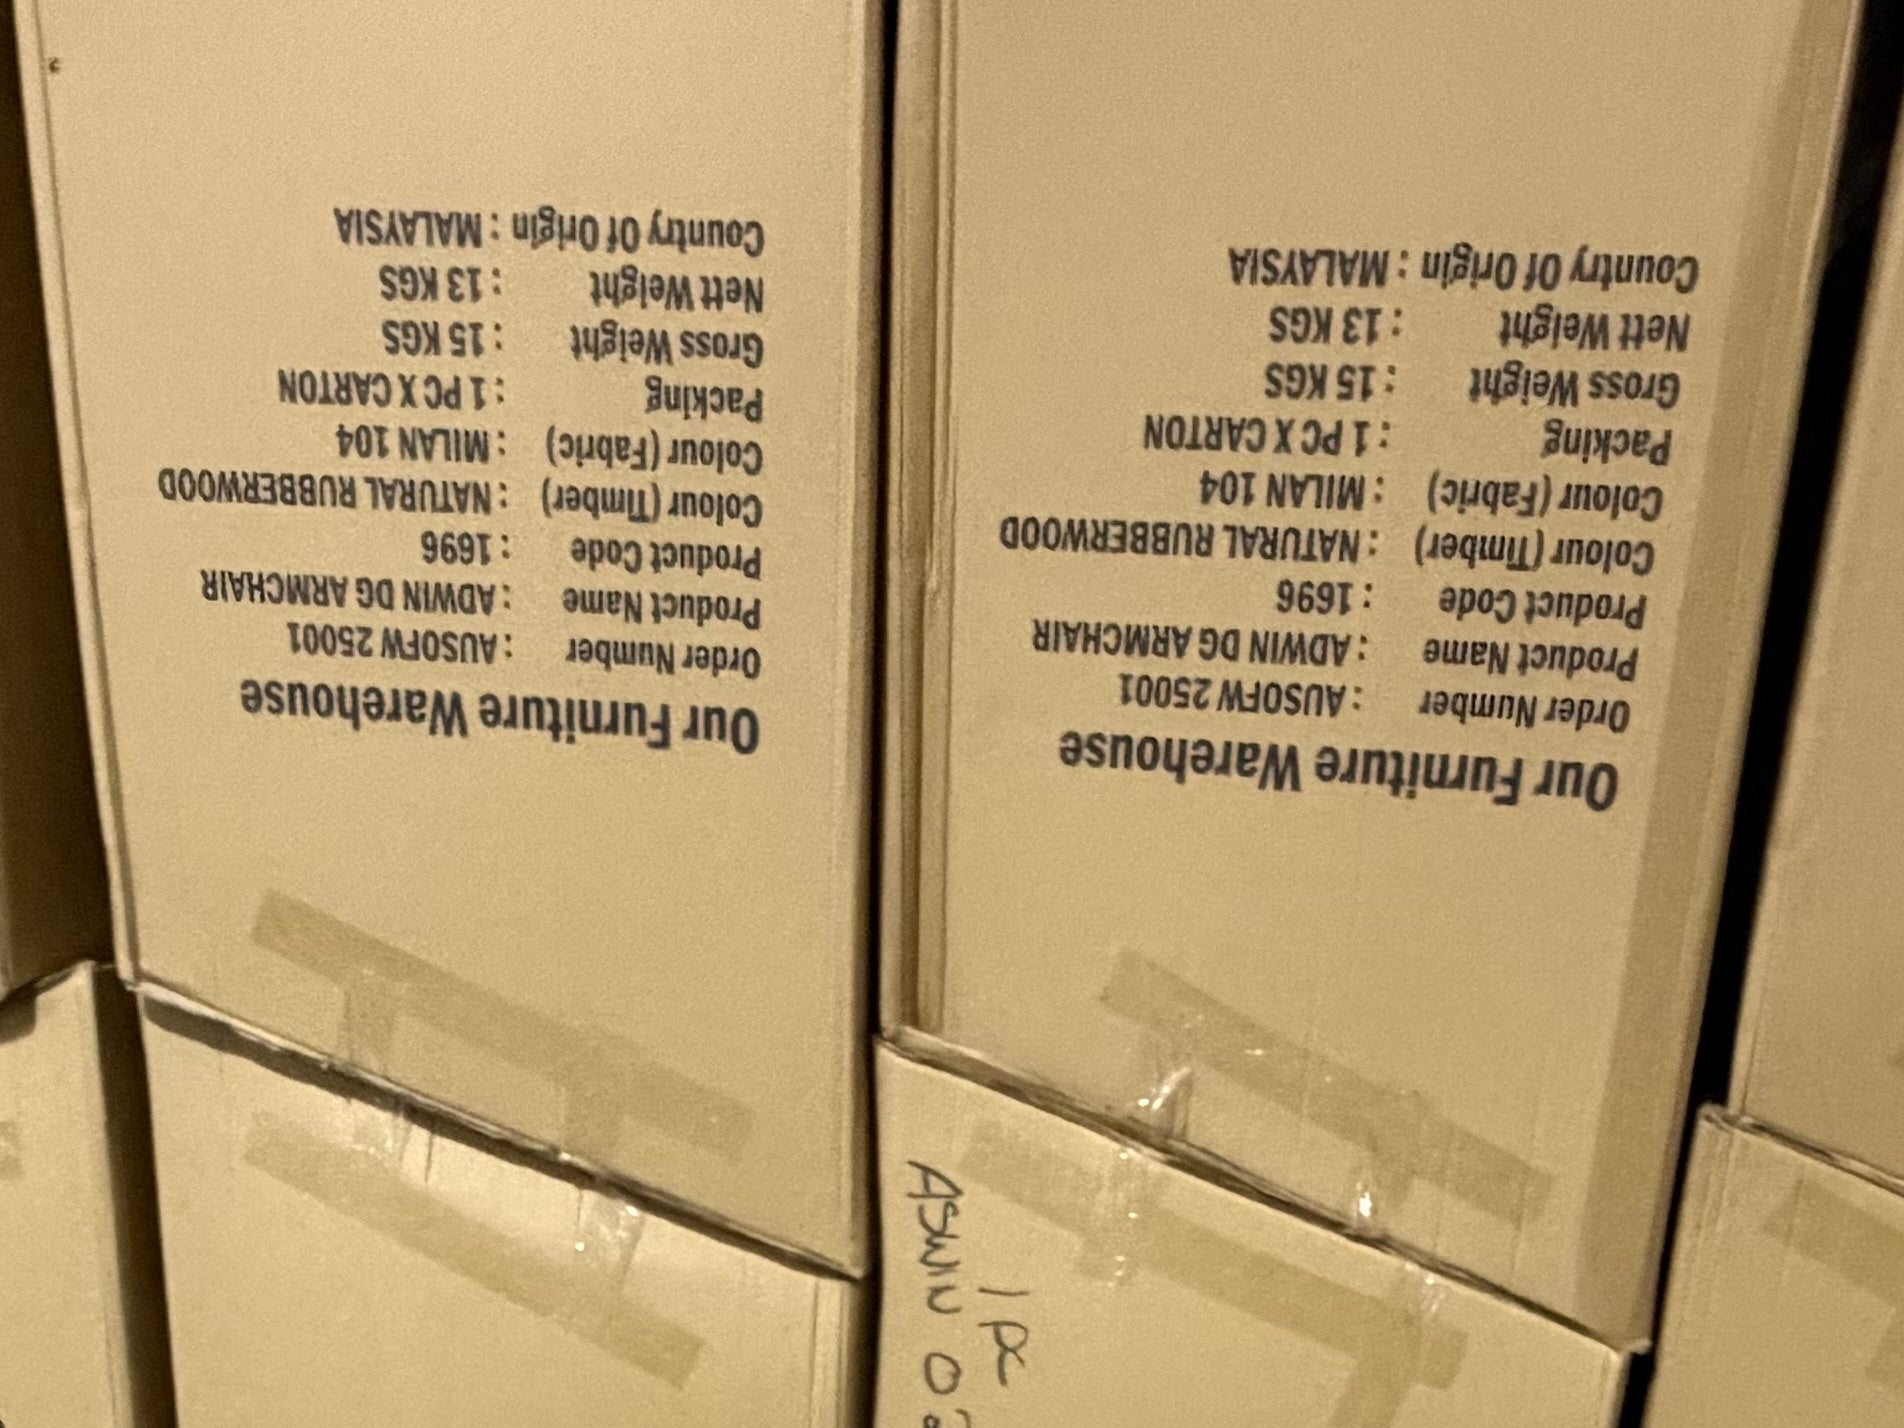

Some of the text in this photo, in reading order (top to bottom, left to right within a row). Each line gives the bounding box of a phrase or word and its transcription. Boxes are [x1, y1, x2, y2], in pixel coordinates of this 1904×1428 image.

[334, 205, 765, 258] Country Of Origin MALAYSIA
[379, 265, 763, 313] Nett Weight 13 KGS
[382, 319, 764, 369] Gross Weight 15 KGS
[279, 369, 763, 423] Packing 1 PC X CARTON
[336, 425, 763, 476] Colour (Fabric) MILAN 104
[159, 469, 763, 528] Colour (Timber) NATURAL RUBBERWOOD
[421, 531, 761, 581] Product Code 1696
[1000, 516, 1655, 576] Colour (Timber) NATURAL RUBBERWOOD
[201, 570, 761, 631] Product Name ADWIN DG ARMCHAIR
[287, 623, 761, 680] Order Number AUSOFW 25001
[1033, 620, 1639, 682] Product Name ADWIN DG ARMCHAIR
[241, 679, 759, 755] Our Furniture Warehouse
[1060, 732, 1619, 811] Our Furniture Warehouse
